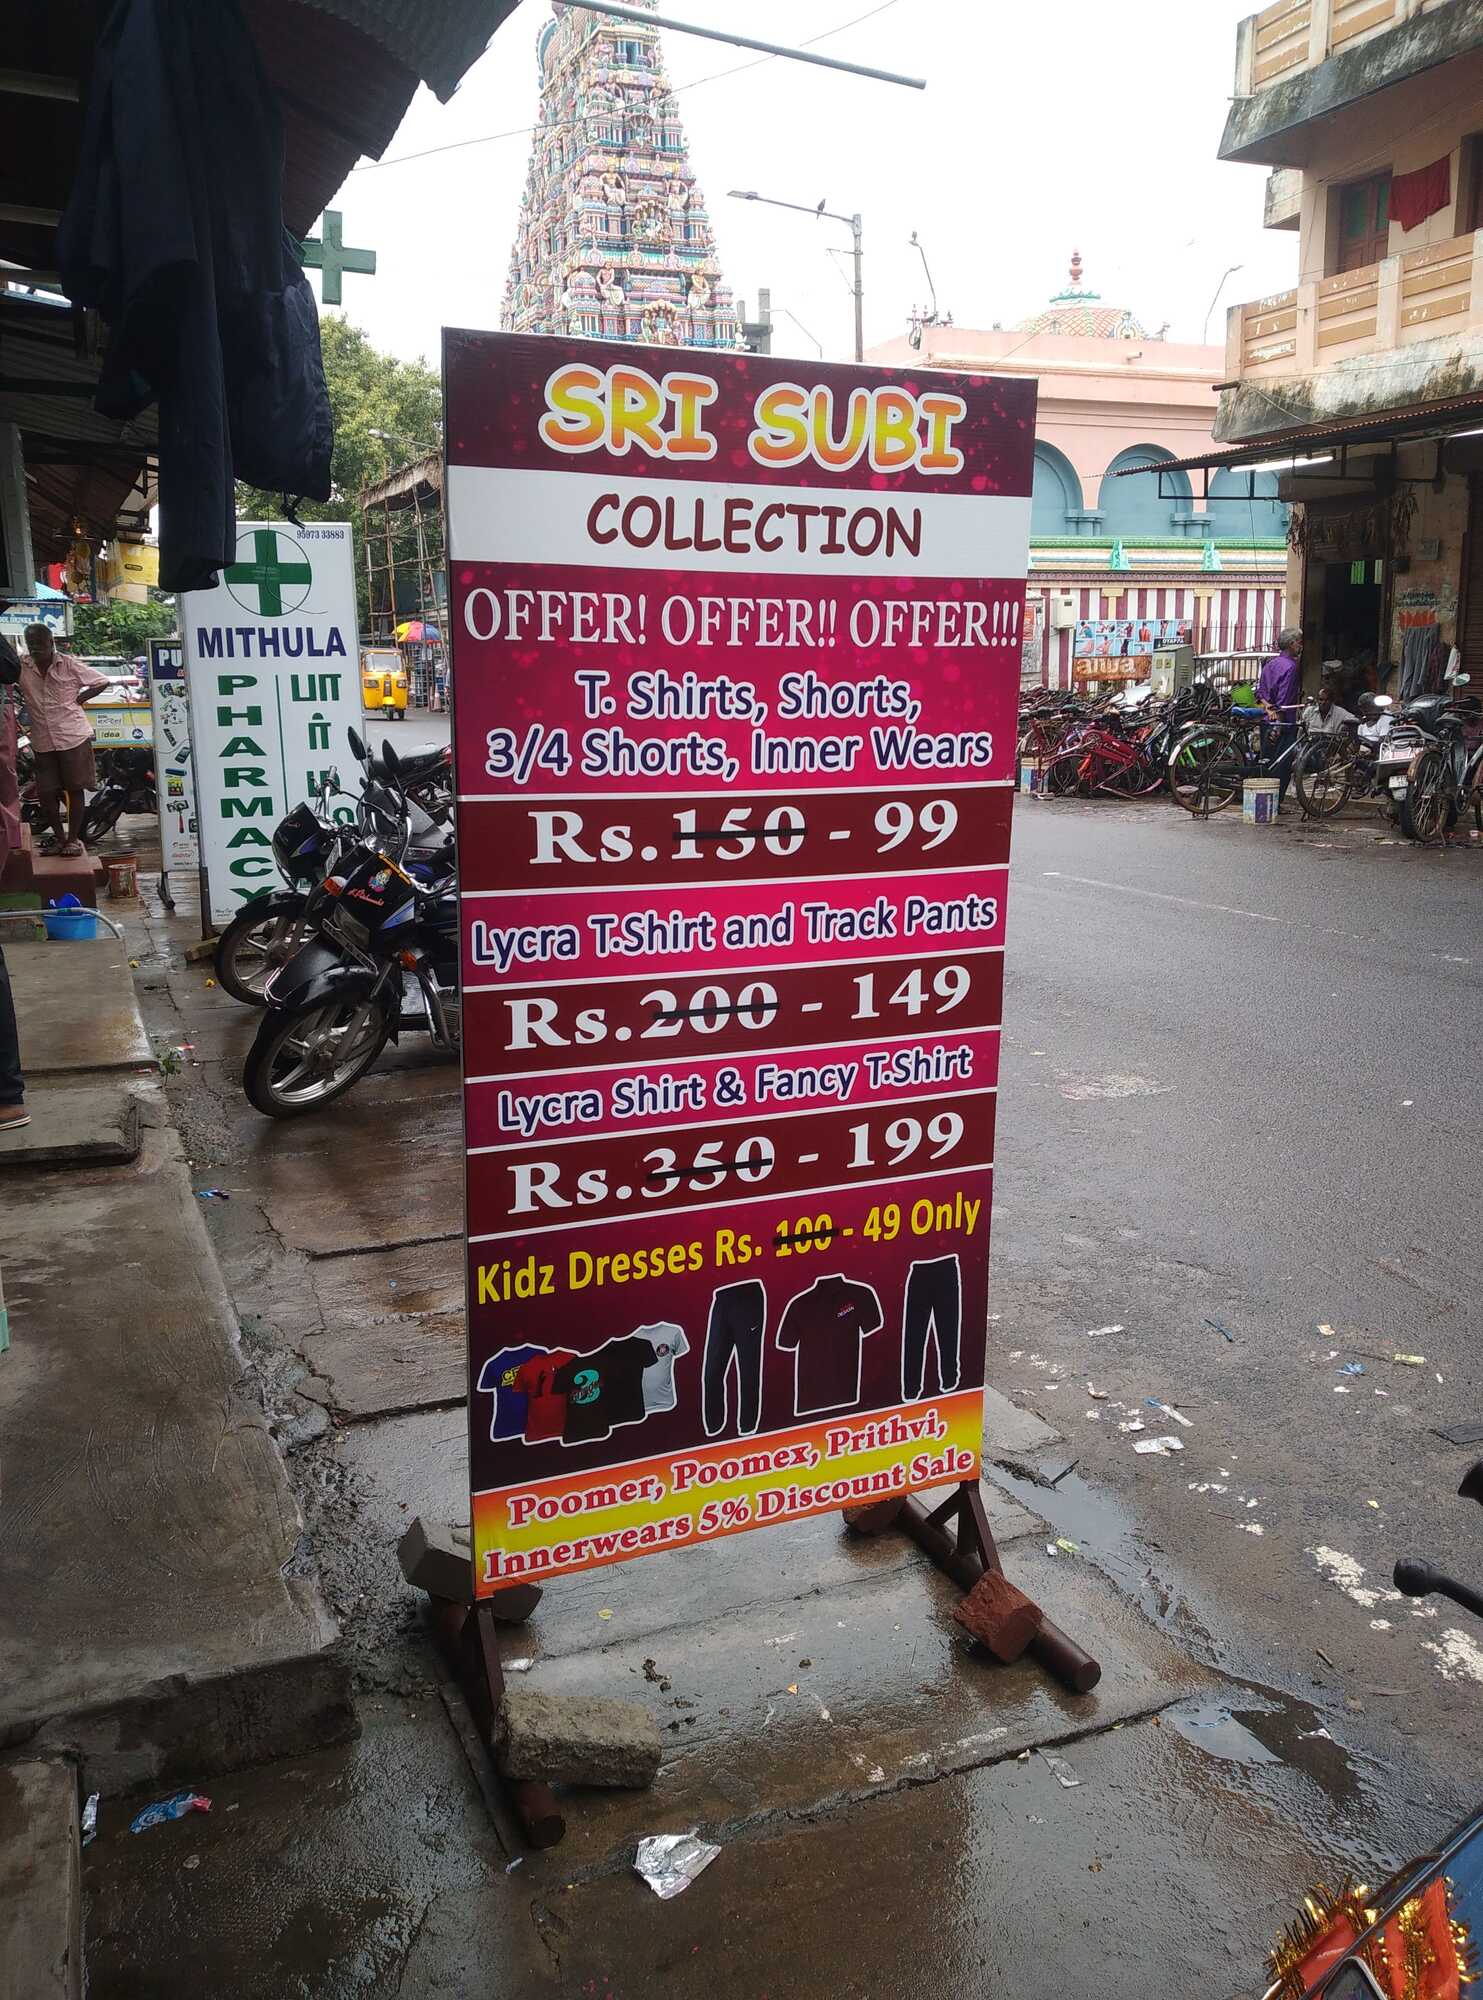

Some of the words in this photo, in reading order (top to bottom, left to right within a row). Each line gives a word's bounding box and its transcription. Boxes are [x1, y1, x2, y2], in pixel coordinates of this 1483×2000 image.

[539, 364, 718, 460] SRI
[748, 382, 967, 475] SUBI
[587, 493, 921, 557] COLLECTION
[198, 626, 347, 658] MITHULA
[465, 589, 647, 645] OFFER!
[662, 596, 836, 647] OFFER!!
[849, 600, 1019, 647] OFFER!!!
[575, 671, 616, 718] T.
[627, 671, 769, 725] Shirts,
[777, 673, 921, 723] Shorts,
[485, 725, 572, 784] 3/4
[582, 731, 739, 782] Shorts,
[752, 729, 862, 773] Inner
[871, 728, 993, 772] Wears
[217, 675, 277, 904] PHARMACY
[874, 800, 958, 853] 99
[471, 918, 577, 974] Lycra
[724, 902, 794, 949] and
[802, 894, 895, 944] Track
[904, 893, 997, 936] Pants
[851, 965, 971, 1019] 149
[498, 1090, 601, 1136] Lycra
[611, 1073, 704, 1116] Shirt
[715, 1067, 743, 1104] &
[755, 1059, 859, 1102] Fancy
[847, 1112, 964, 1168] 199
[477, 1255, 555, 1303] Kidz
[569, 1240, 703, 1289] Dresses
[715, 1230, 762, 1266] Rs.
[773, 1214, 838, 1258] 100
[863, 1205, 901, 1242] 49
[911, 1192, 981, 1238] Only
[508, 1472, 664, 1527] Poomer,
[671, 1444, 819, 1492] Poomex,
[826, 1409, 947, 1459] Prithvi,
[483, 1501, 691, 1583] Innerwears
[698, 1499, 750, 1534] 5%
[757, 1464, 907, 1522] Discount
[910, 1447, 973, 1485] Sale
